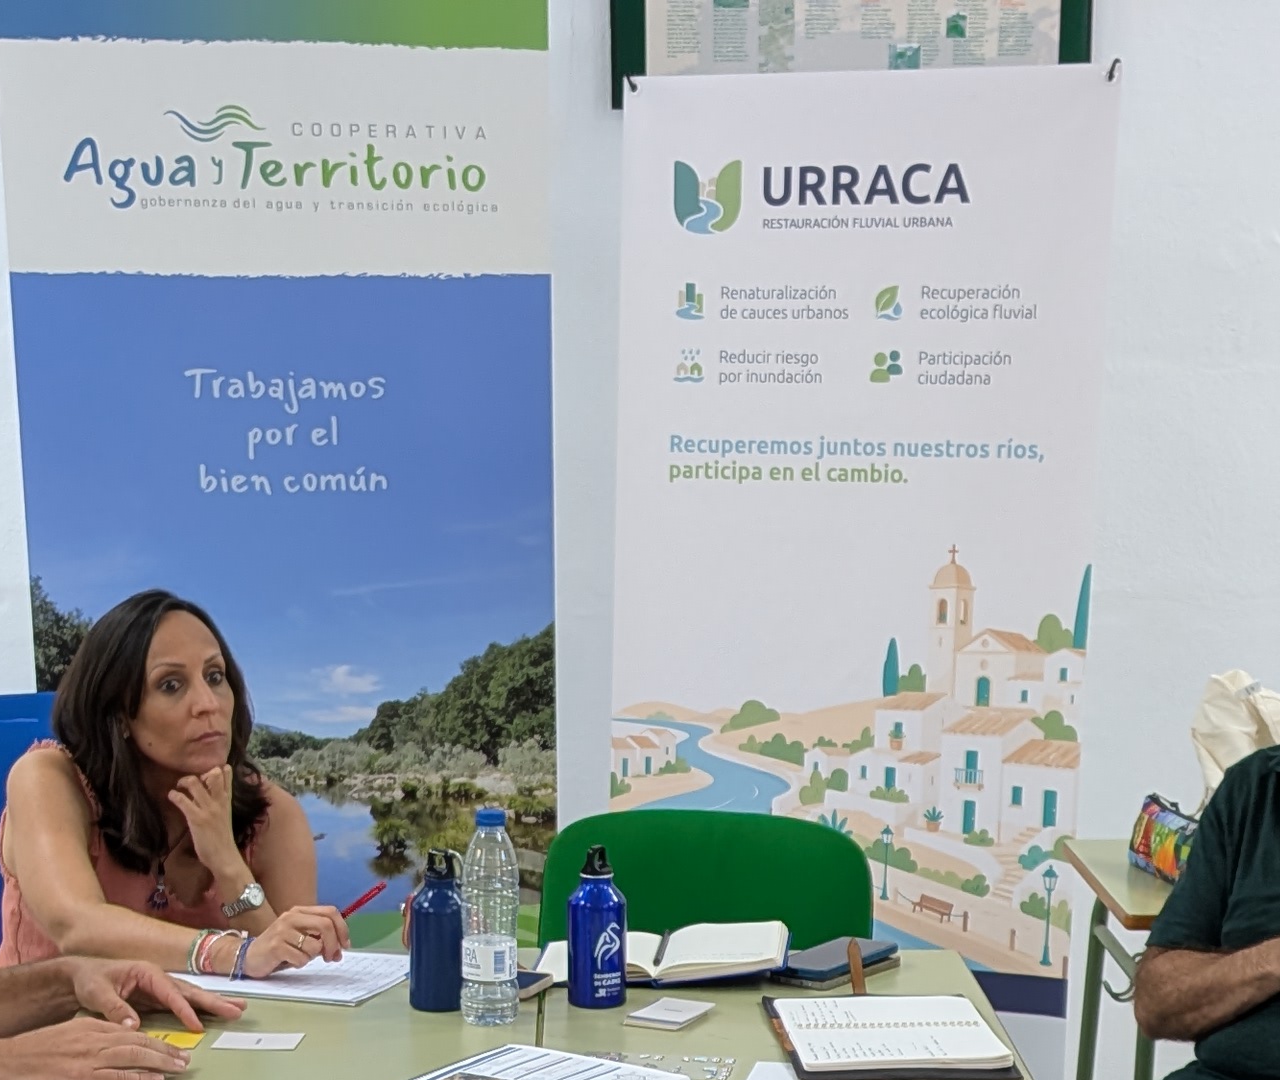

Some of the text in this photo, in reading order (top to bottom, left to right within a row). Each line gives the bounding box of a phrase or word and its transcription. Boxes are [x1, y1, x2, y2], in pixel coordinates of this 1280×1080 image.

[292, 122, 488, 140] COOPERATIVA
[63, 137, 487, 210] Agua y Territorio
[763, 162, 971, 206] URRACA
[140, 196, 499, 215] gobernanza del agua y transición ecológica
[763, 215, 954, 230] RESTAURACIÓN FLUVIAL URBANA
[720, 284, 837, 300] Renaturalización
[921, 284, 1020, 302] Recuperación
[720, 305, 849, 320] de cauces urbanos
[920, 304, 1038, 323] ecológica fluvial
[719, 349, 819, 368] Reducir riesgo
[918, 351, 1012, 368] Participación
[719, 370, 823, 386] por inundación
[917, 371, 992, 386] ciudadana
[184, 367, 386, 415] Trabajamos
[248, 415, 338, 460] por el
[670, 434, 1045, 463] Recuperemos juntos nuestros ríos,
[199, 463, 388, 496] bien común
[669, 460, 909, 485] participa en el cambio.
